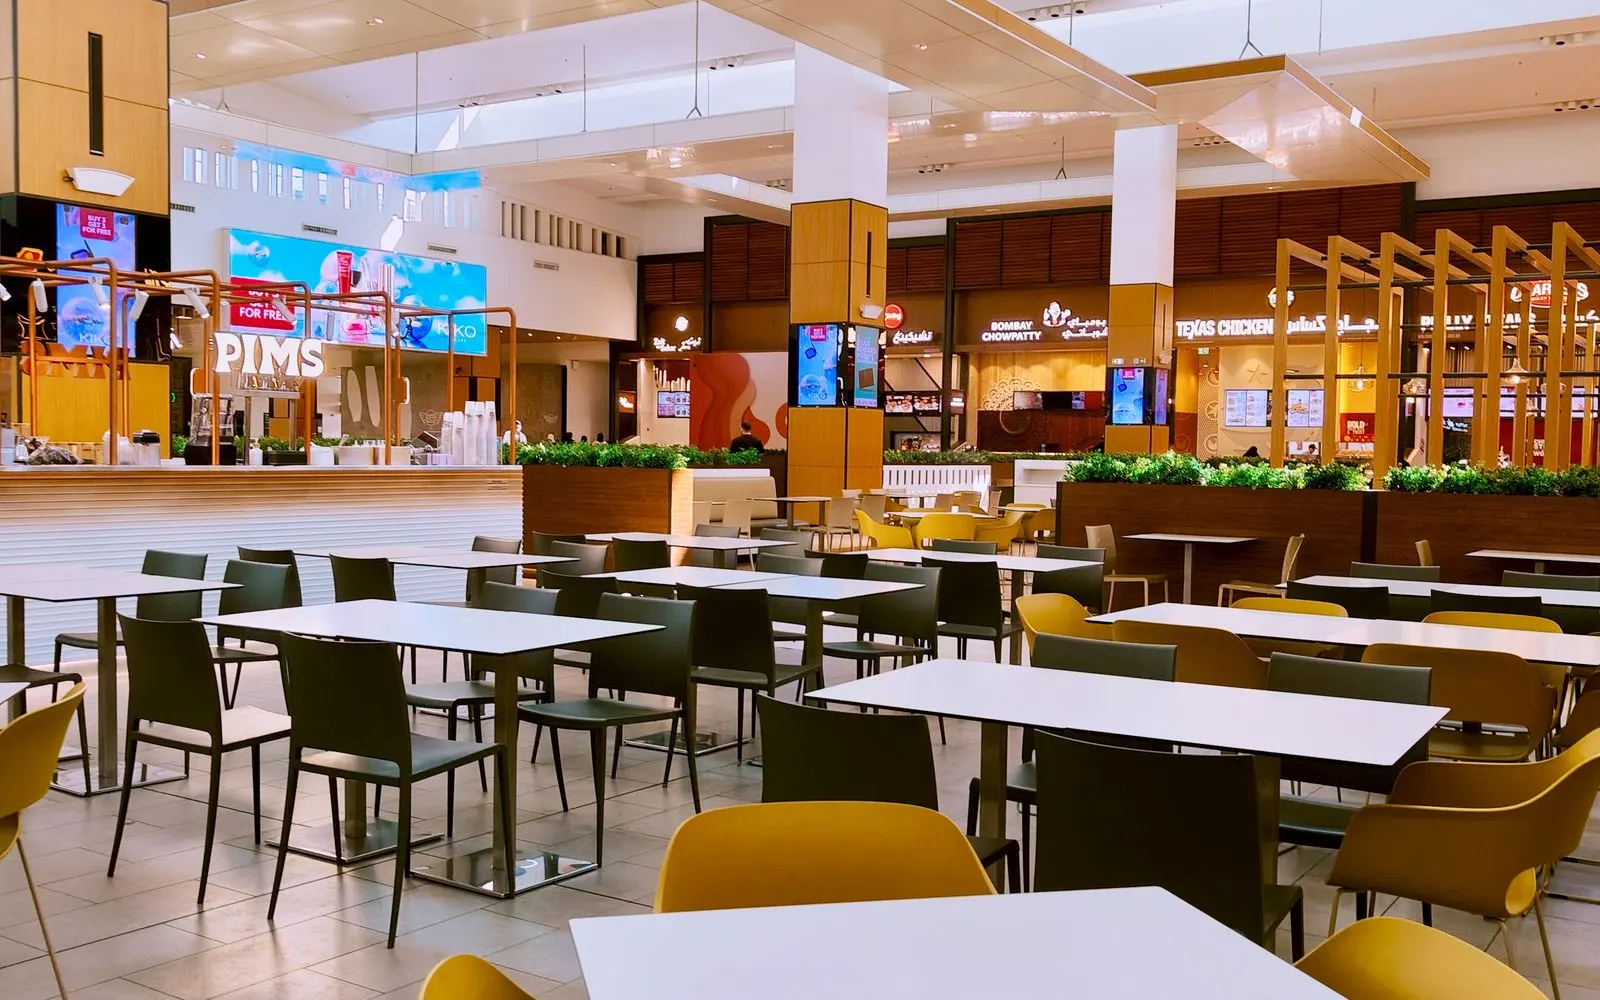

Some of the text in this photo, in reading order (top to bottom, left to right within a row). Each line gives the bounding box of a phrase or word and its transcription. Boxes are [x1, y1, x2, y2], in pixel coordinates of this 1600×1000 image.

[87, 214, 102, 222] BUY
[82, 226, 112, 236] FOR FREE
[239, 306, 261, 319] FOR
[991, 320, 1034, 332] BOMBAY
[1175, 318, 1275, 340] TEXAS CHICKEN
[981, 330, 1042, 342] CHOWPATTY
[214, 332, 324, 378] PIMS
